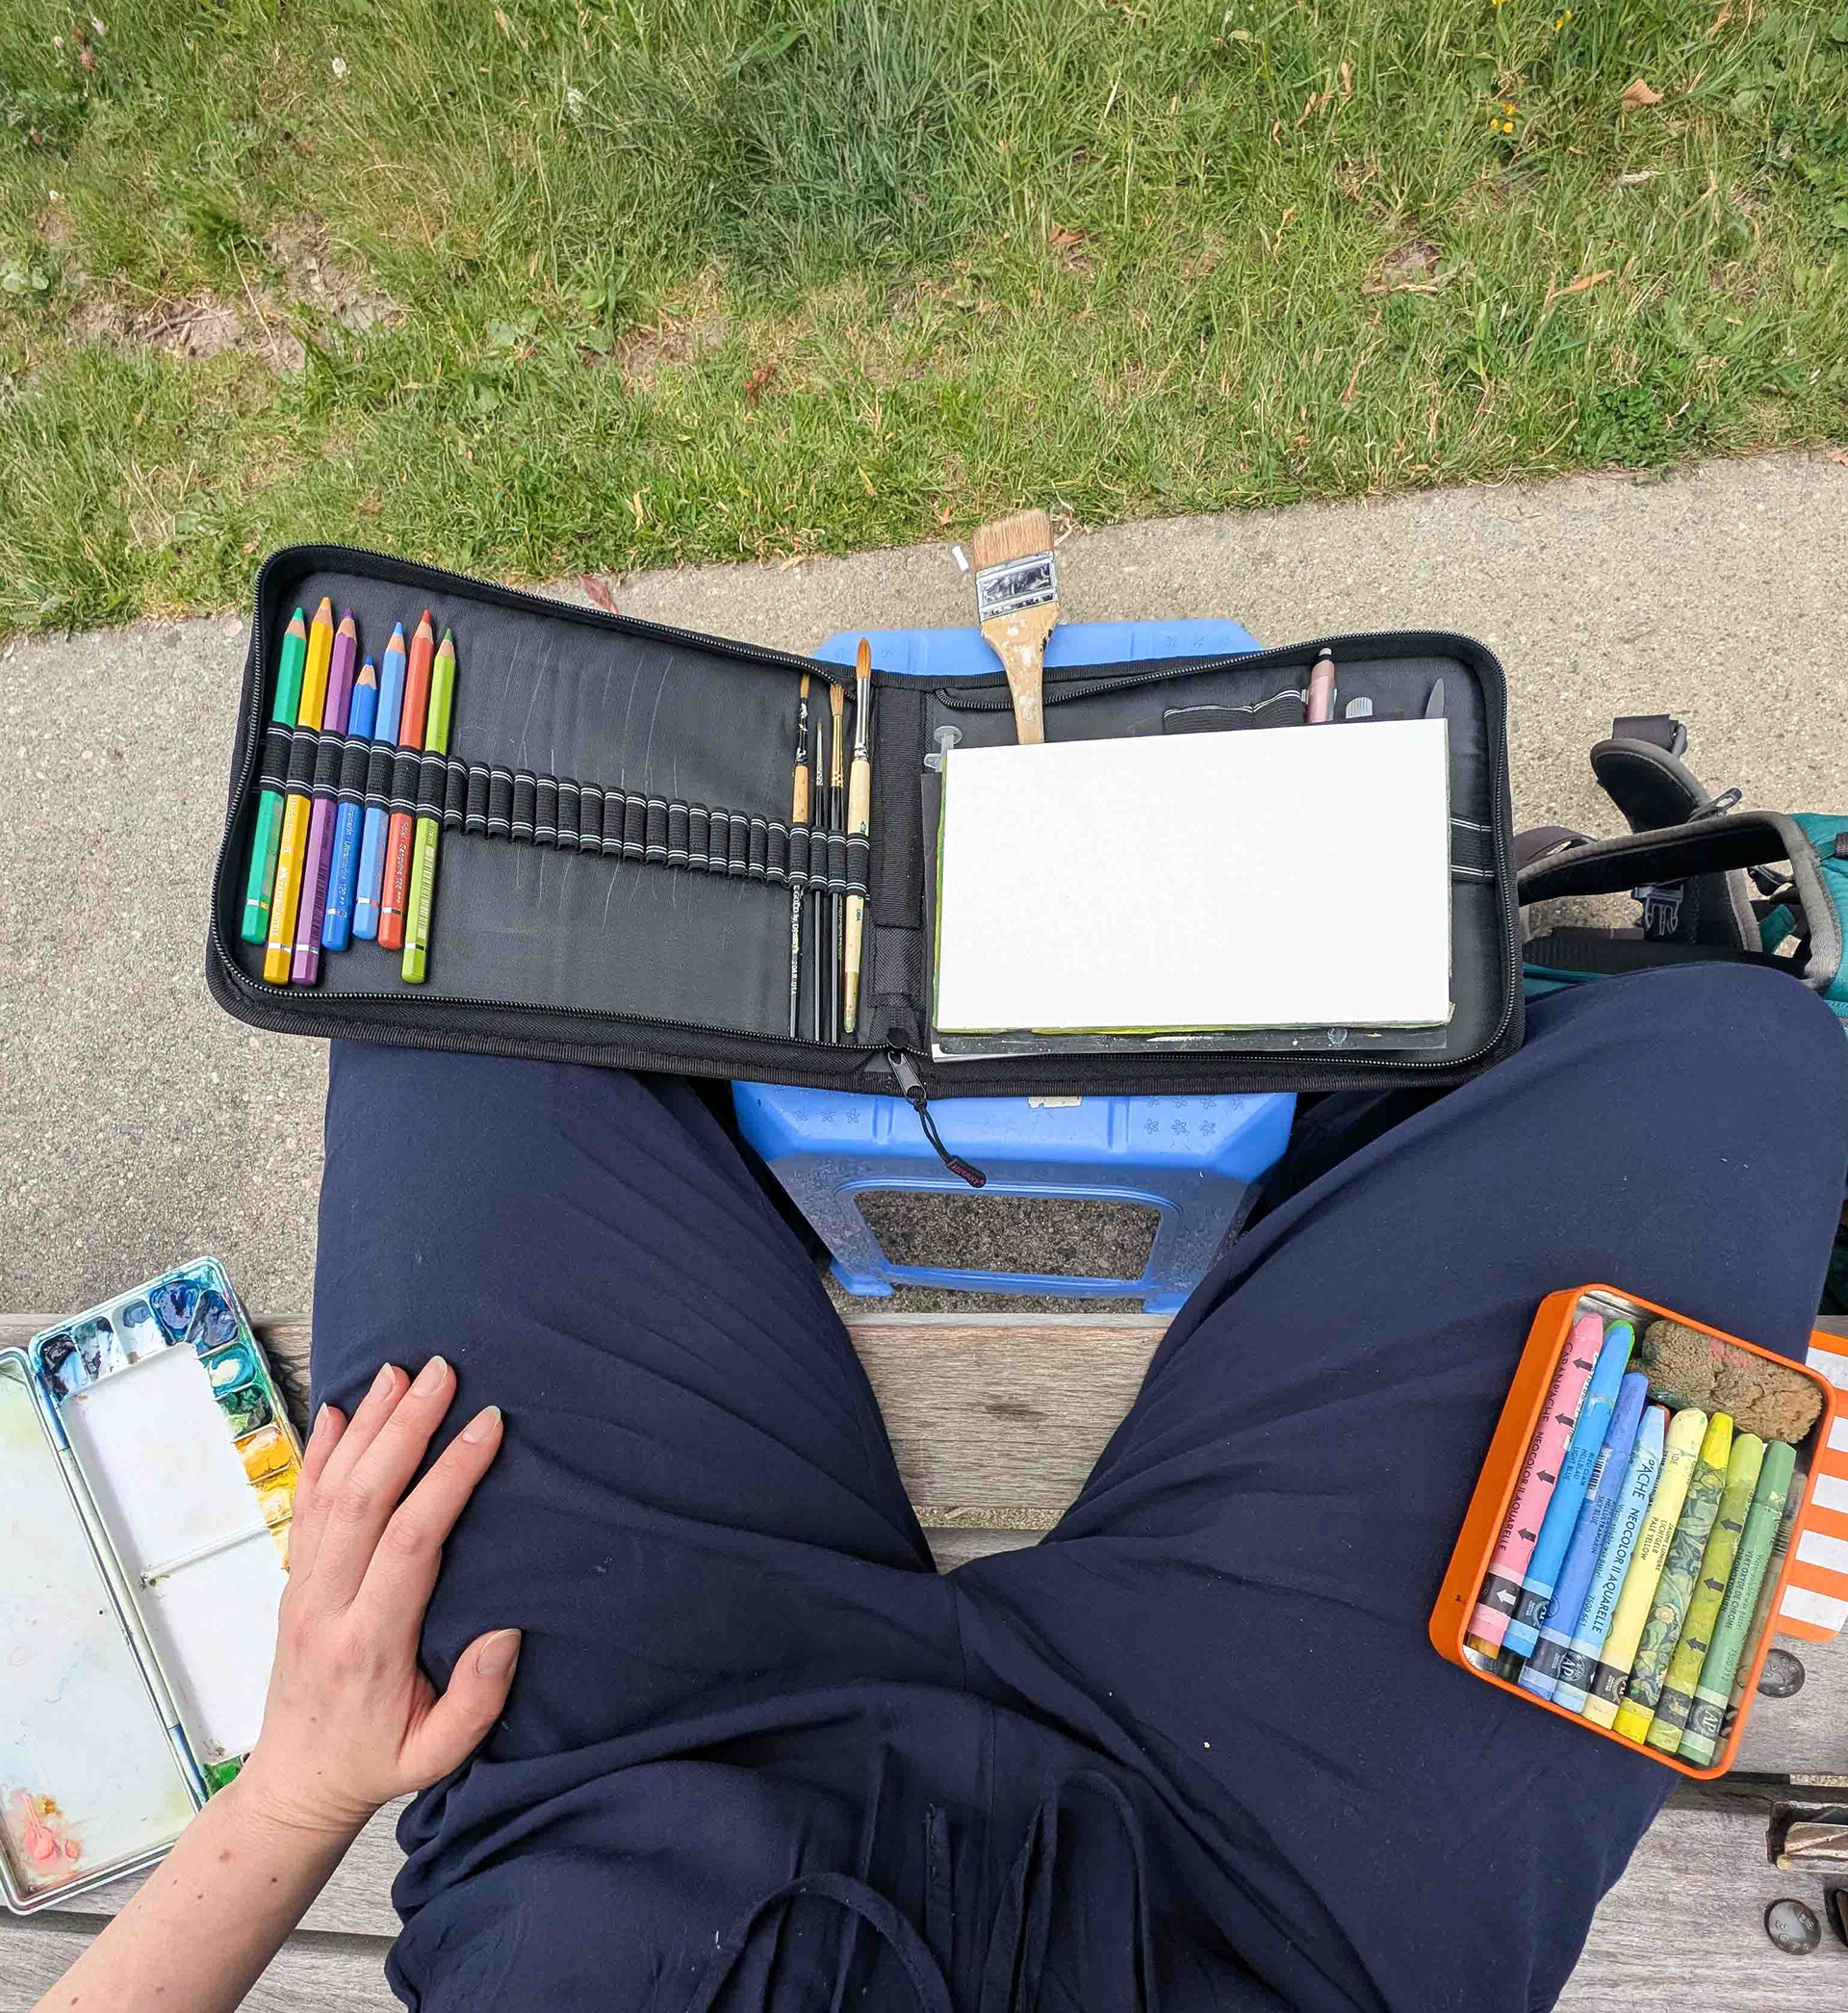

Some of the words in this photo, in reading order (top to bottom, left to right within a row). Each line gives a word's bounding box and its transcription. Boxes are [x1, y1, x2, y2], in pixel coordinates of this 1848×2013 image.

[1519, 1430, 1545, 1485] NEOCOLOR
[1567, 1445, 1579, 1464] LIGHT
[1572, 1448, 1587, 1480] HELLBLAU
[1562, 1463, 1574, 1481] BLUE
[1594, 1494, 1604, 1508] SKY
[1497, 1494, 1523, 1551] AQUARELLE
[1589, 1508, 1600, 1525] BLUE
[1648, 1516, 1658, 1532] PALE
[1613, 1507, 1640, 1564] NEOCOLOR
[1652, 1519, 1667, 1554] LICHTGELB
[1663, 1522, 1674, 1543] JAUNE
[1639, 1533, 1653, 1560] YELLOW
[1742, 1549, 1753, 1566] VERT
[1735, 1566, 1748, 1589] OXYDE
[1590, 1573, 1618, 1633] AQUARELLE
[1732, 1589, 1741, 1599] DE
[1724, 1600, 1738, 1629] CHROME
[1558, 1656, 1576, 1676] AP
[1699, 1710, 1720, 1732] AP
